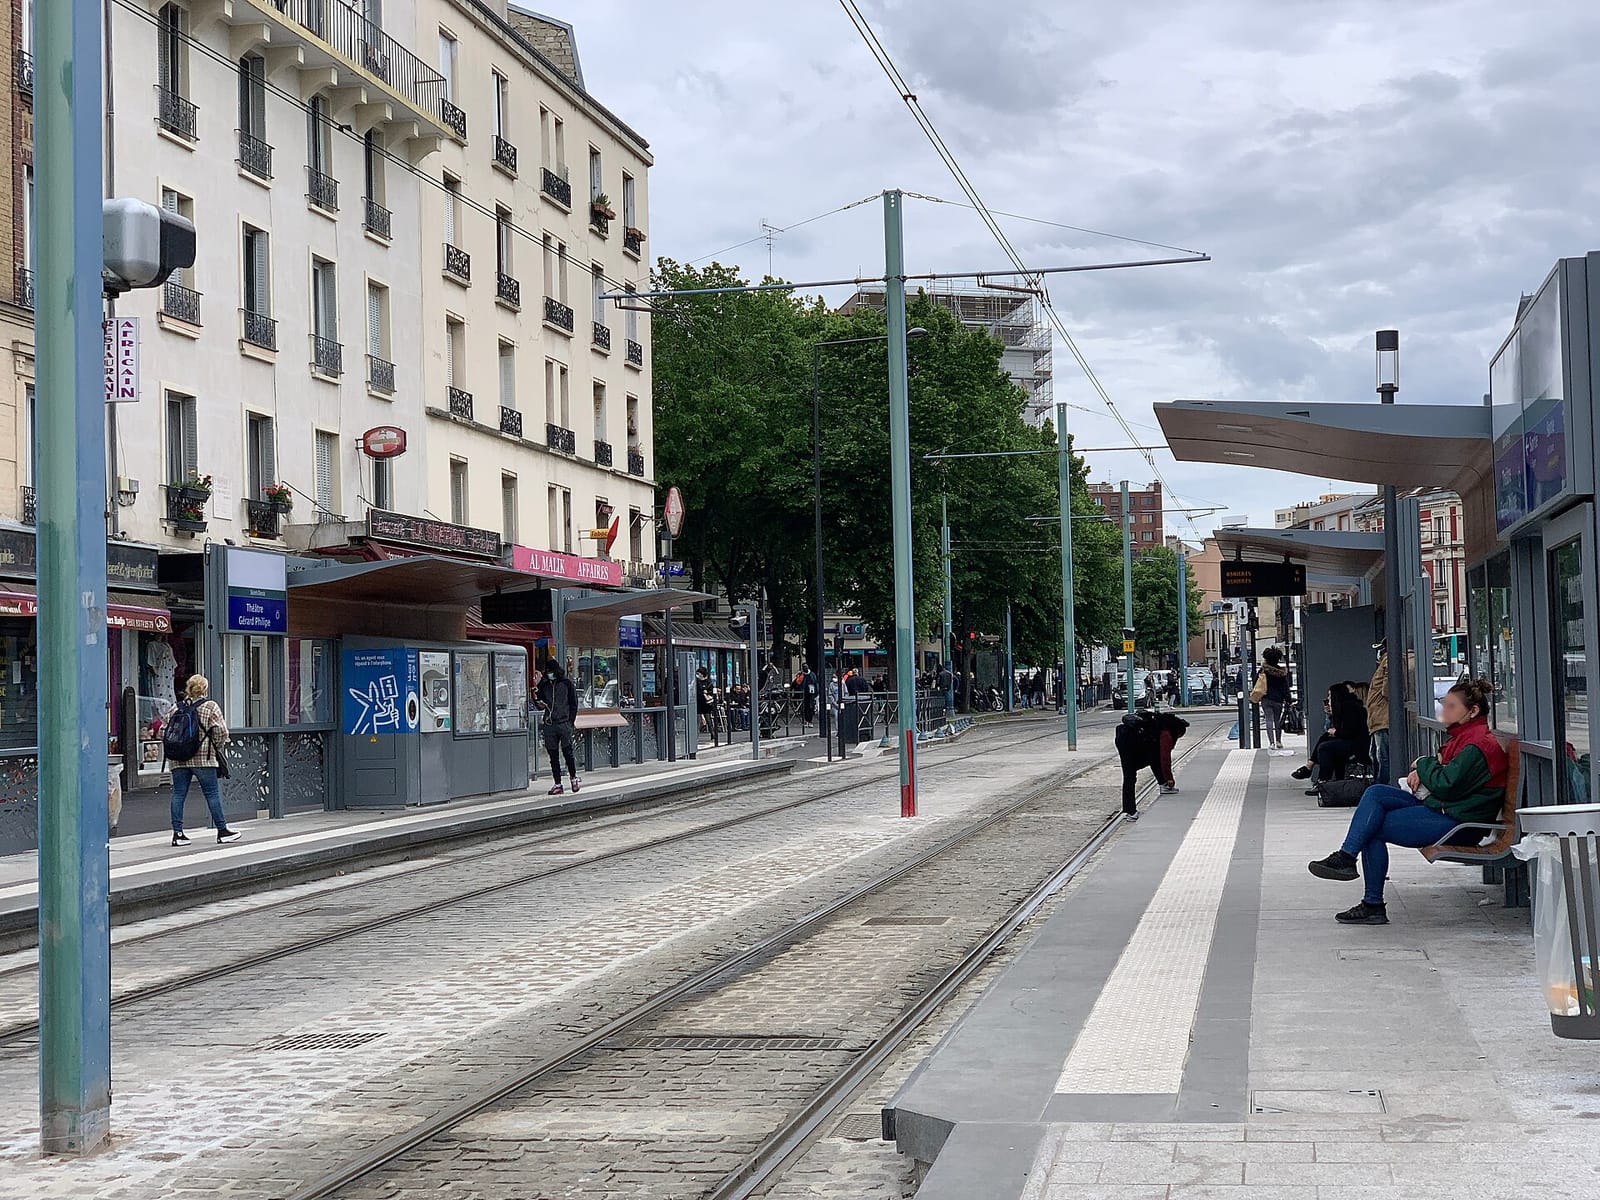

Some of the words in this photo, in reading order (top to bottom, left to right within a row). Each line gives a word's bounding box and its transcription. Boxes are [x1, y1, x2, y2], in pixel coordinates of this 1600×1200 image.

[104, 320, 114, 400] RESTAURANT
[121, 320, 135, 398] AFRICAIN
[529, 553, 540, 570] AL
[541, 555, 565, 574] MALIK
[577, 562, 609, 580] AFFAIRES
[246, 603, 264, 614] Théâtre
[238, 616, 254, 626] Gérard
[255, 617, 271, 629] Philipe
